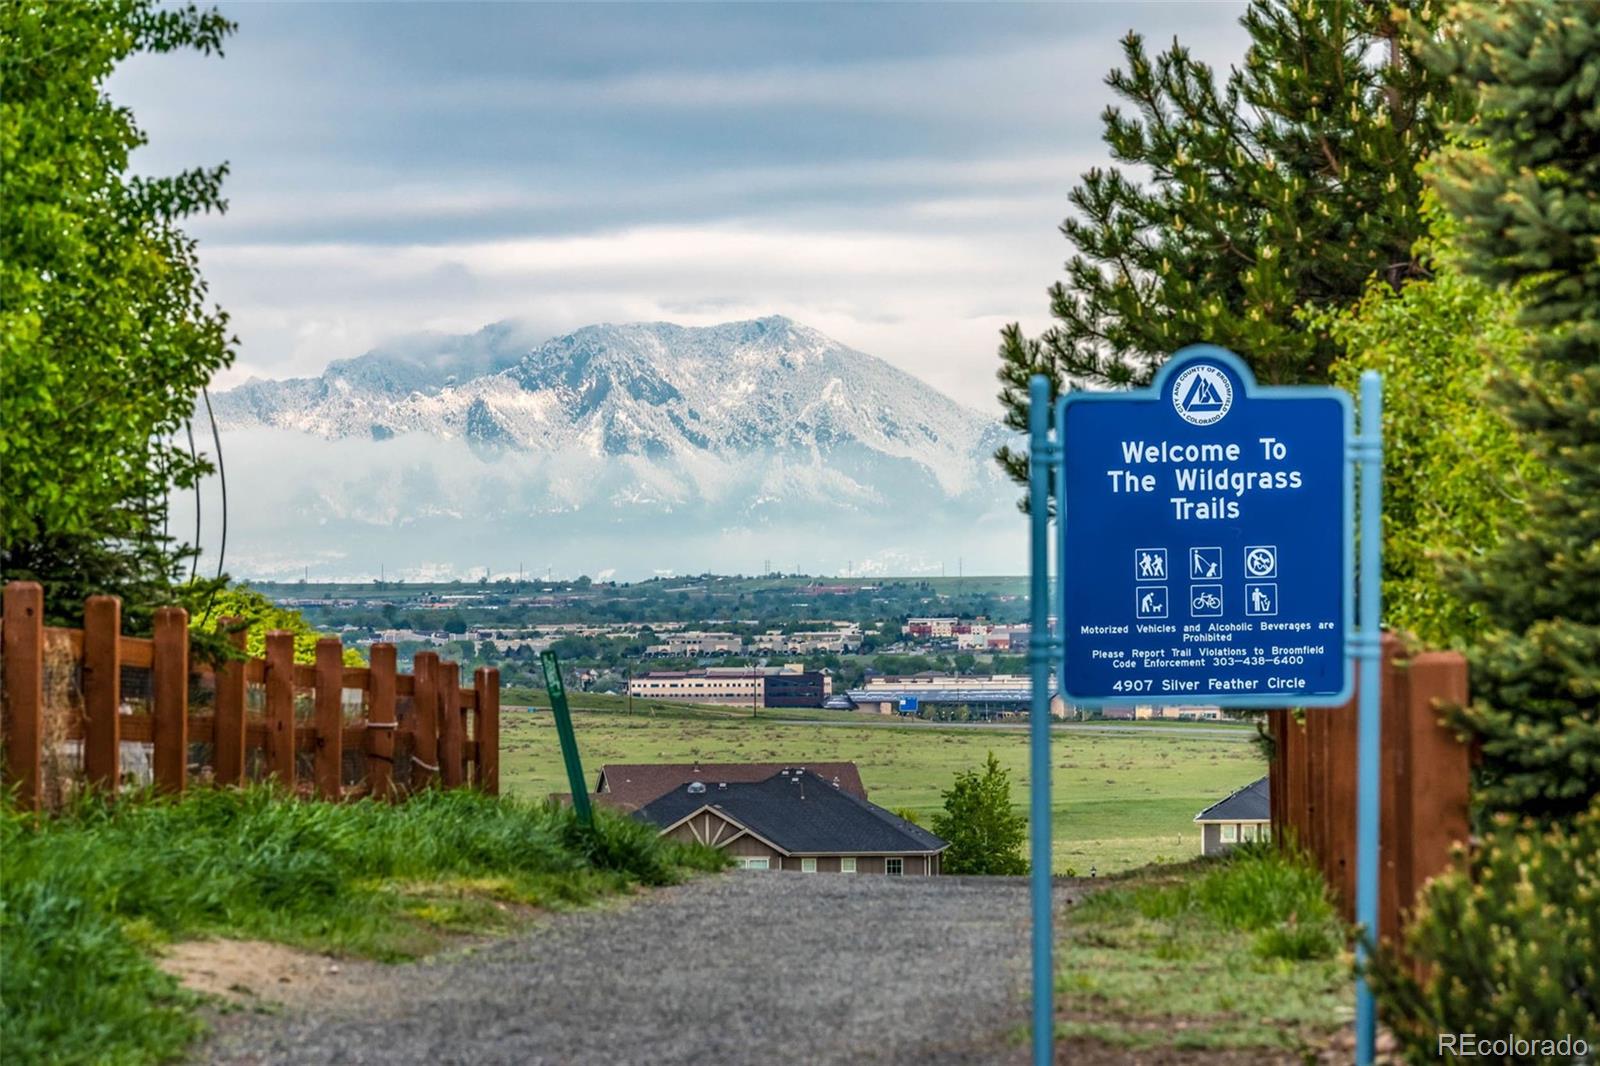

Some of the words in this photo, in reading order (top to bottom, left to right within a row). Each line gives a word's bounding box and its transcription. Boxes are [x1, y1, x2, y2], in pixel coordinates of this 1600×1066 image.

[1180, 367, 1205, 382] COUNTY
[1174, 382, 1182, 397] AND
[1216, 372, 1232, 413] BROOMFIELD
[1174, 399, 1184, 414] CITY
[1186, 414, 1221, 425] COLORADO
[1121, 440, 1241, 464] Welcome
[1258, 437, 1287, 461] To
[1107, 470, 1156, 493] The
[1174, 468, 1303, 497] Wildgrass
[1170, 497, 1240, 520] Trails
[1080, 625, 1129, 635] Motorized
[1136, 624, 1177, 633] Vehicles
[1183, 623, 1201, 633] and
[1208, 622, 1253, 632] Alcoholic
[1260, 621, 1312, 633] Beverages
[1318, 622, 1335, 630] are
[1182, 633, 1232, 642] Prohibited
[1092, 649, 1125, 659] Please
[1131, 648, 1165, 660] Report
[1171, 648, 1192, 657] Trail
[1198, 647, 1247, 657] Violations
[1254, 647, 1265, 656] to
[1271, 645, 1325, 655] Broomfield
[1112, 659, 1137, 669] Code
[1143, 657, 1206, 668] Enforcement
[1213, 655, 1304, 667] 303-438-6400
[1112, 679, 1153, 692] 4907
[1162, 679, 1200, 691] Silver
[1208, 678, 1259, 690] Feather
[1267, 677, 1306, 689] Circle
